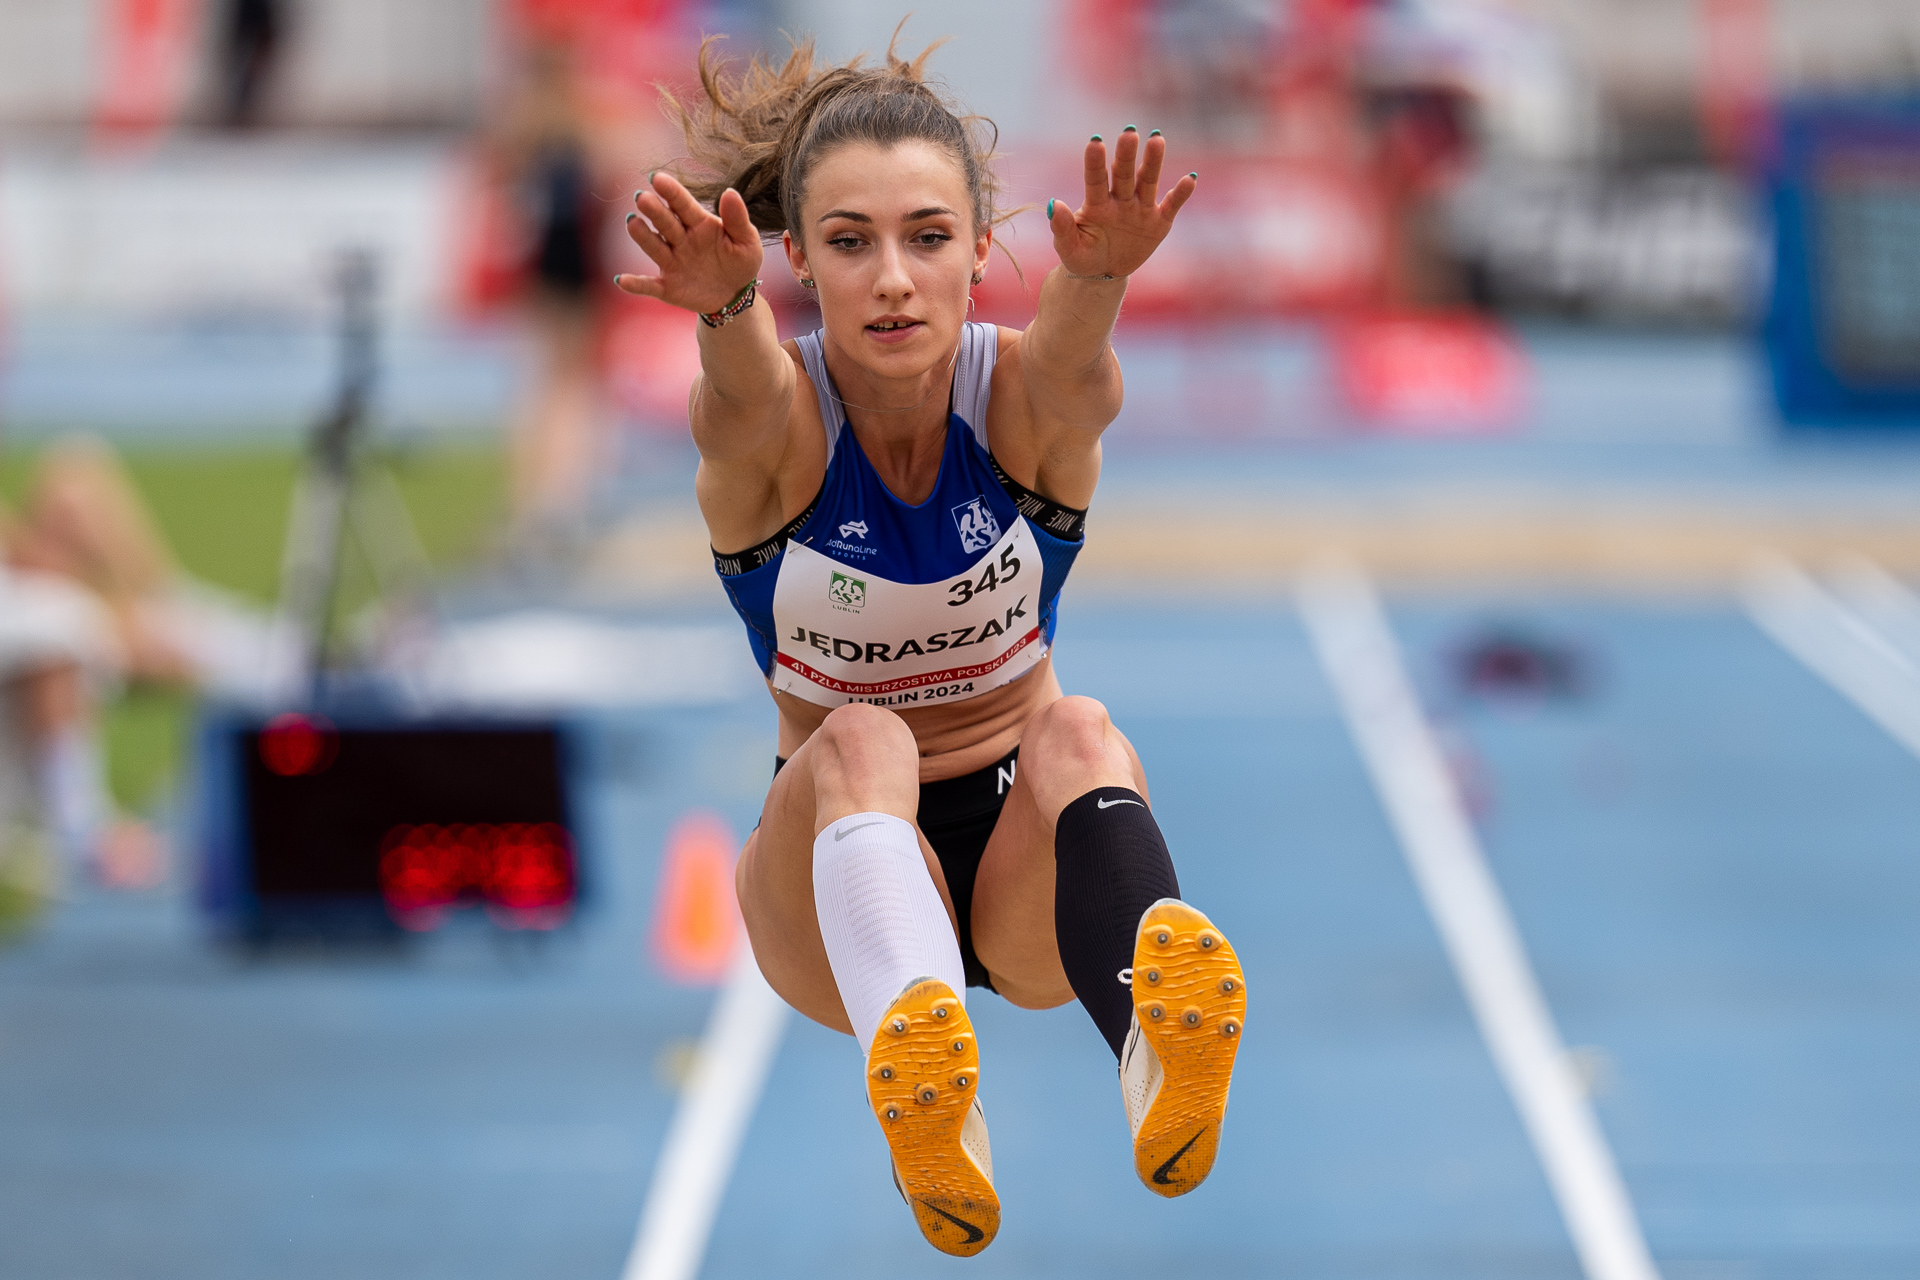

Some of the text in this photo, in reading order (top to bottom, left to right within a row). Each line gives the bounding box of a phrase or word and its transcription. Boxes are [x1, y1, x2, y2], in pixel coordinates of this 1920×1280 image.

[1046, 509, 1079, 532] NIKE
[753, 541, 781, 566] NIKE
[716, 556, 742, 576] NIKE
[946, 543, 1022, 607] 345
[832, 604, 861, 614] LUBLIN
[790, 594, 1028, 664] JĘDRASZAK
[791, 638, 1027, 693] 41. PZLA MISTRZOSTWA POLSKI U23
[923, 682, 975, 700] 2024
